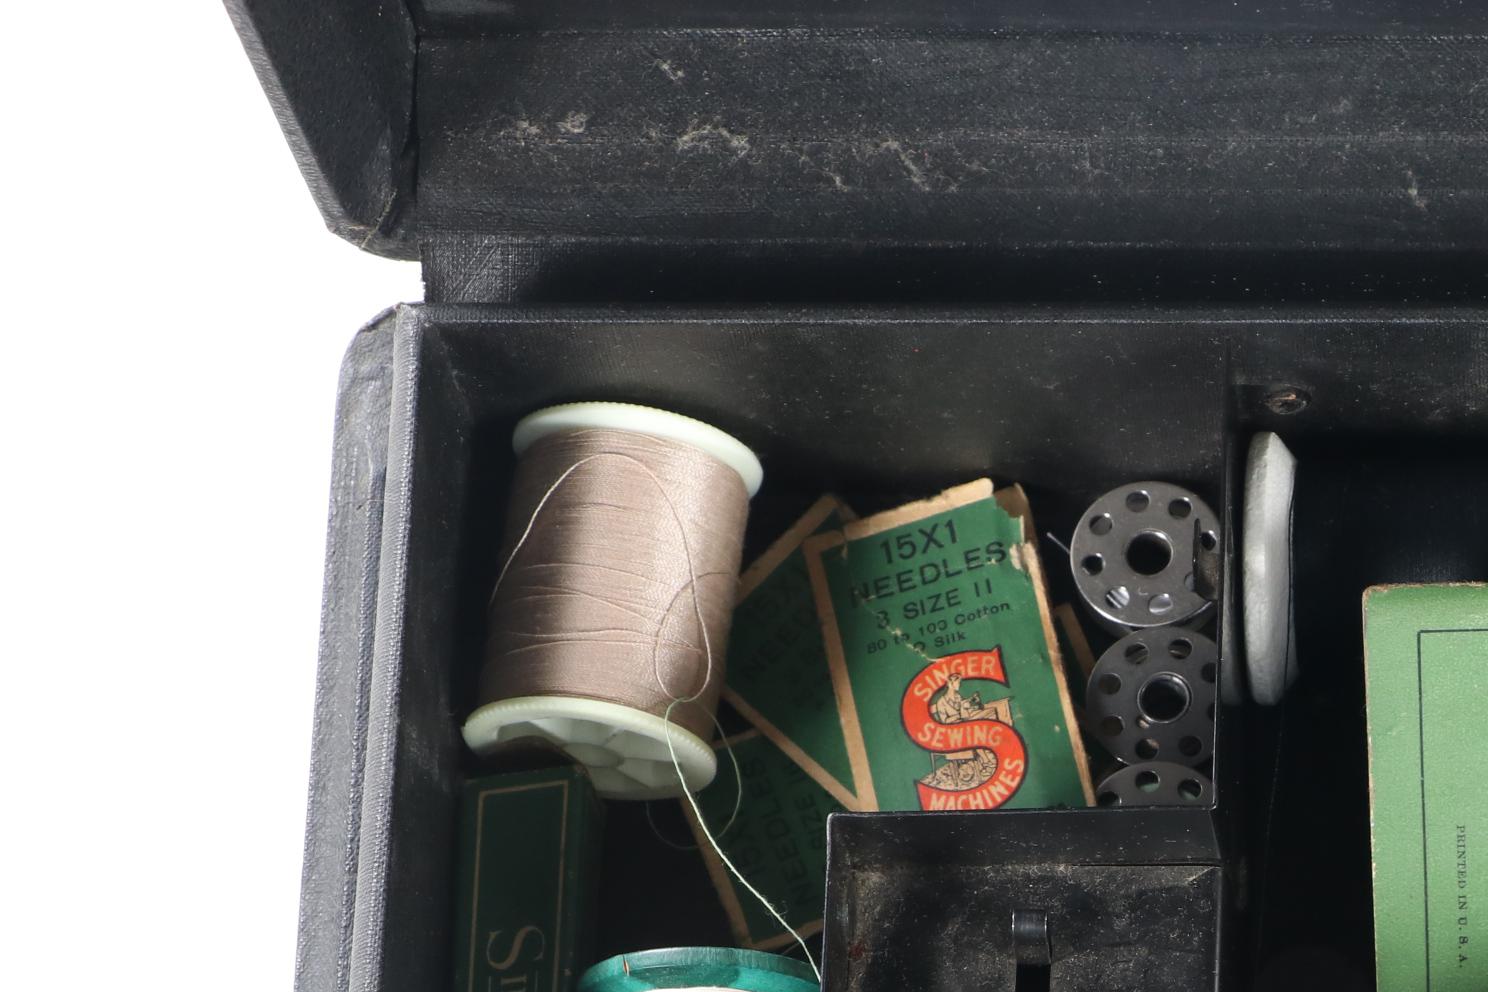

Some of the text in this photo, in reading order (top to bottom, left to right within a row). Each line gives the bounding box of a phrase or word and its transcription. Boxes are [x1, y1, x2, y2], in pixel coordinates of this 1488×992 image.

[880, 519, 958, 564] 15X1
[851, 541, 1008, 607] NEEDLES
[903, 588, 962, 620] SIZE
[867, 639, 887, 654] 80
[955, 603, 1011, 624] Cotton
[935, 632, 967, 648] Silk
[914, 655, 996, 703] SINGER
[917, 722, 1003, 747] SEWING
[929, 757, 1025, 811] MACHINES
[1456, 825, 1467, 888] PRINTED
[1457, 895, 1467, 911] IN
